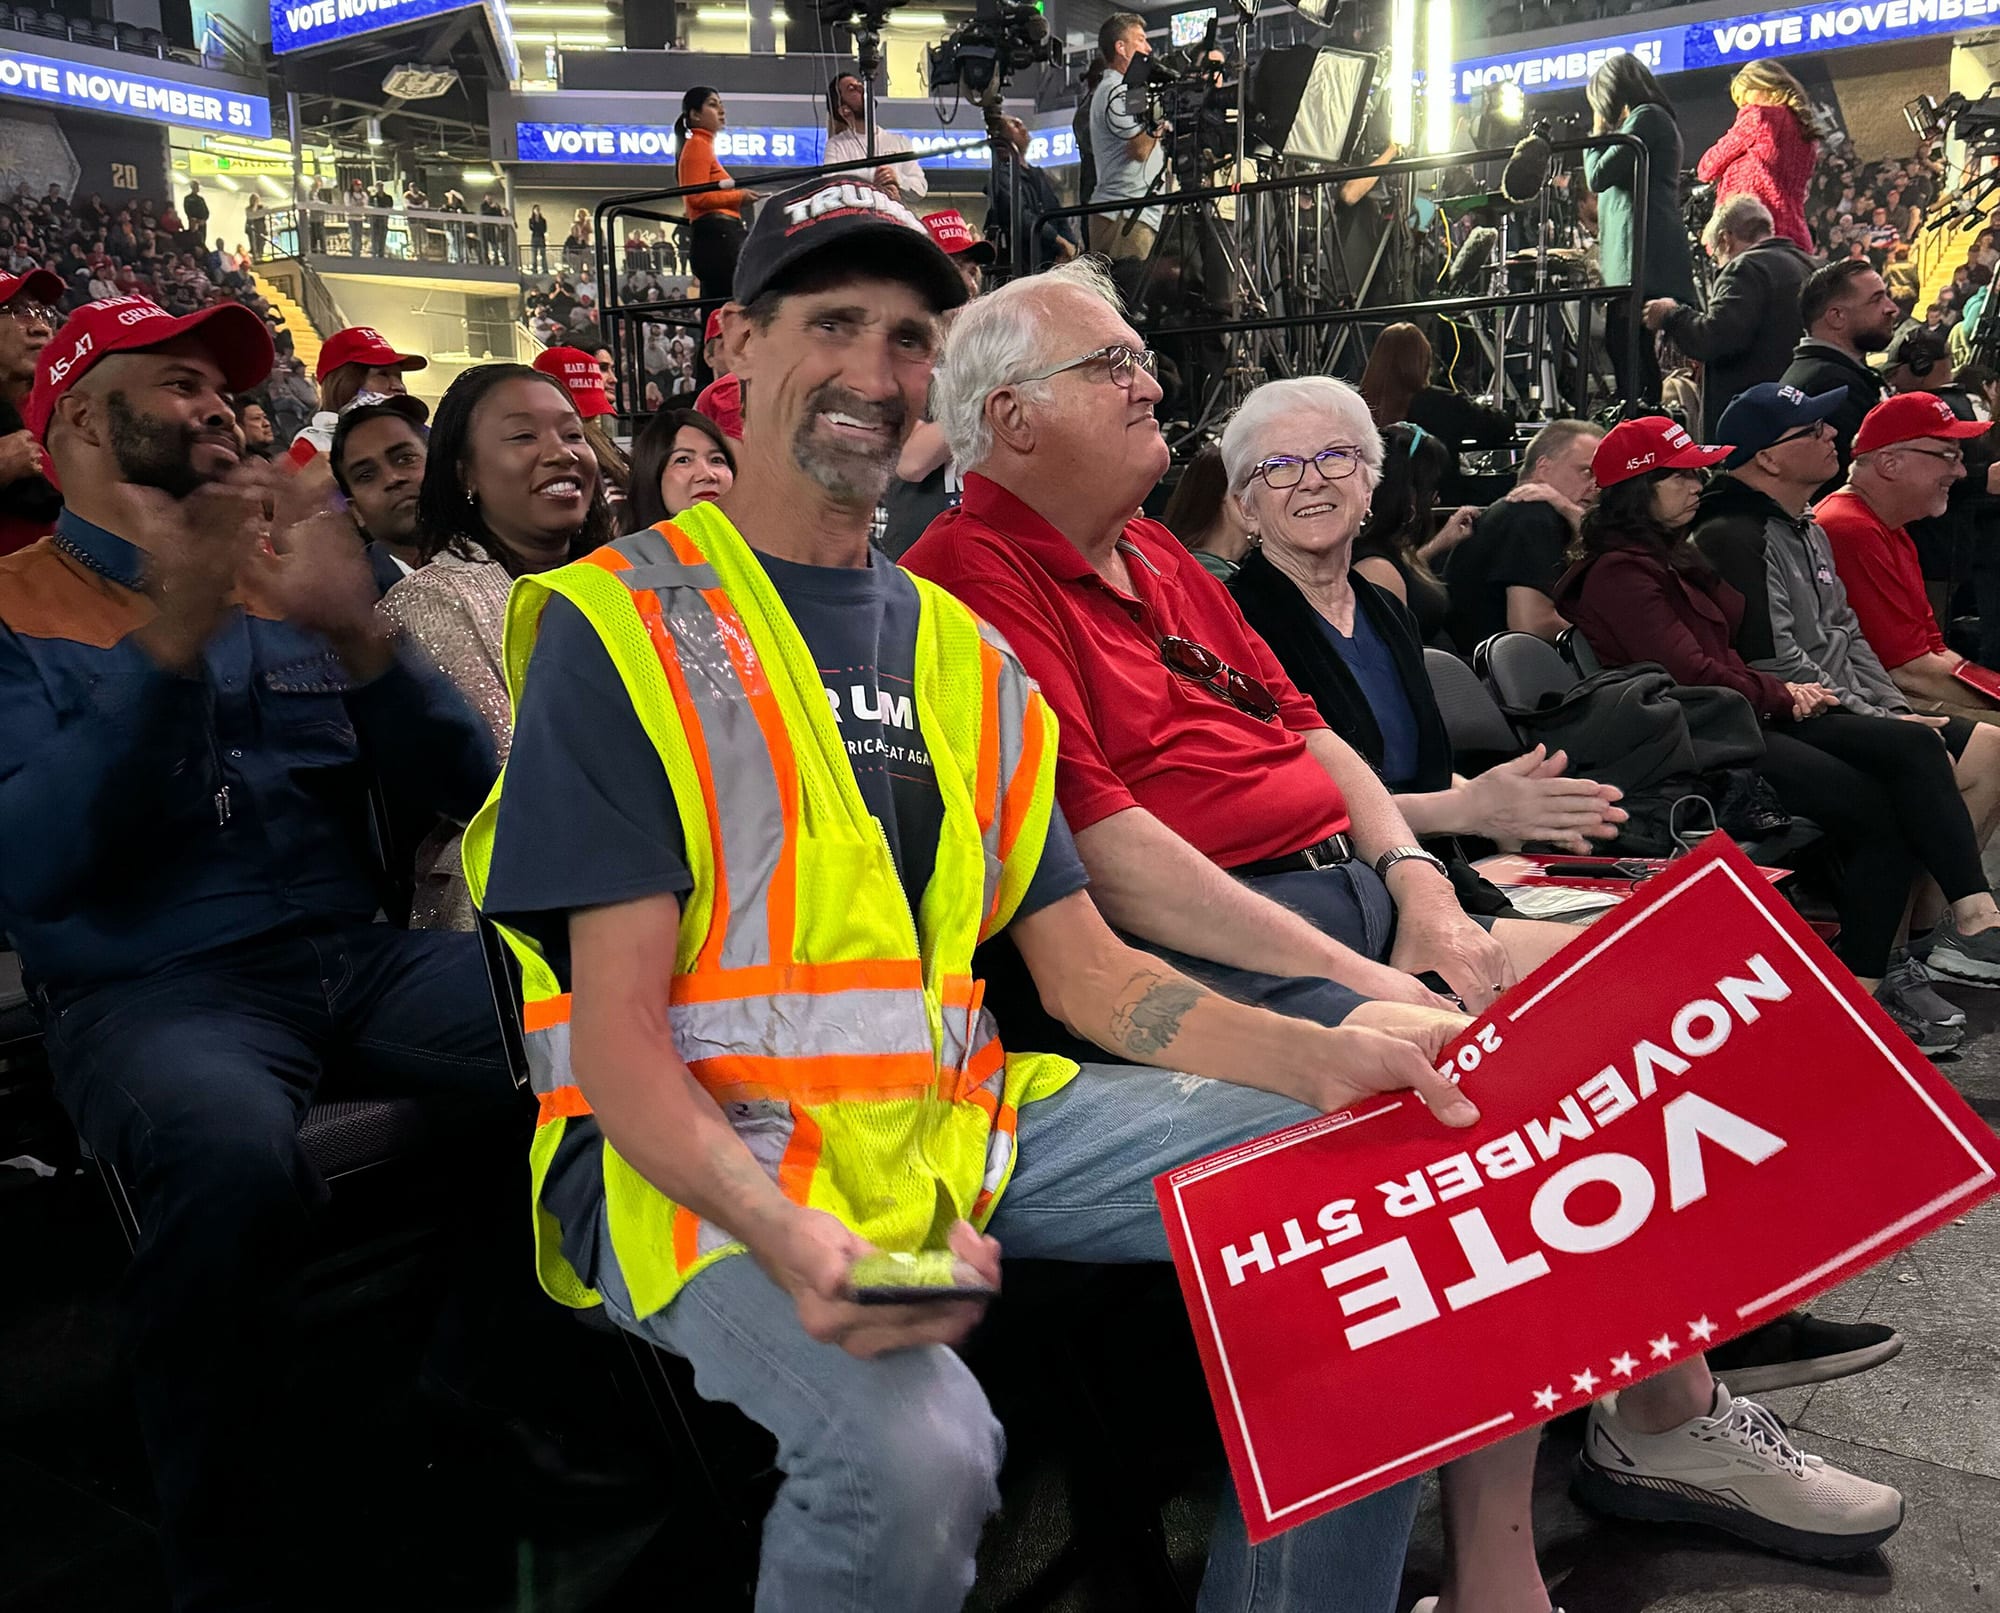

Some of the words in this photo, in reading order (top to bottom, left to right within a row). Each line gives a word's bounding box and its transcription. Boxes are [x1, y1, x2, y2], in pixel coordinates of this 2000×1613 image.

[286, 4, 336, 33] VOTE
[1713, 16, 1803, 54] VOTE
[1810, 0, 2000, 40] NOVEMBE
[0, 59, 61, 93] OTE
[66, 71, 223, 122] NOVEMBER
[228, 101, 253, 127] 5!
[542, 131, 615, 154] VOTE
[620, 131, 767, 156] NOVBER
[771, 135, 796, 156] 5!
[1052, 133, 1073, 156] 5!
[111, 163, 139, 190] 20
[49, 333, 94, 386] 45-47
[1626, 452, 1655, 470] 45-47
[1375, 953, 1793, 1218] NOVEMBER
[1219, 1198, 1364, 1287] 5TH
[1319, 1090, 1788, 1351] VOTE
